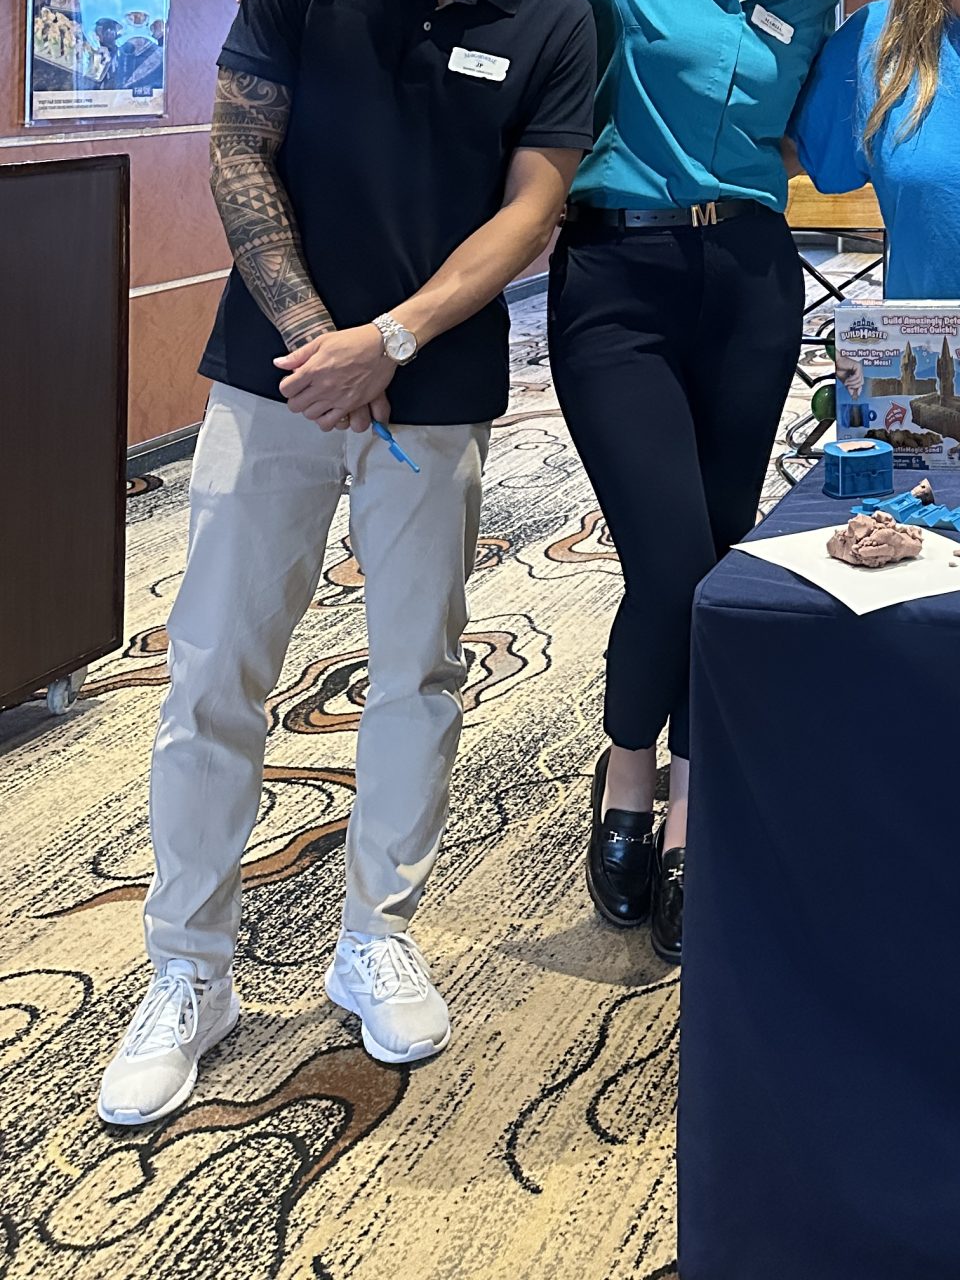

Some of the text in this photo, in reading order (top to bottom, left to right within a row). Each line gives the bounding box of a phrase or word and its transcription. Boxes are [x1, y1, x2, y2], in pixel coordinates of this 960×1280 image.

[883, 317, 902, 325] Build
[904, 317, 942, 327] Amazingly
[901, 326, 957, 335] Castles Quickly
[871, 350, 883, 358] Dry
